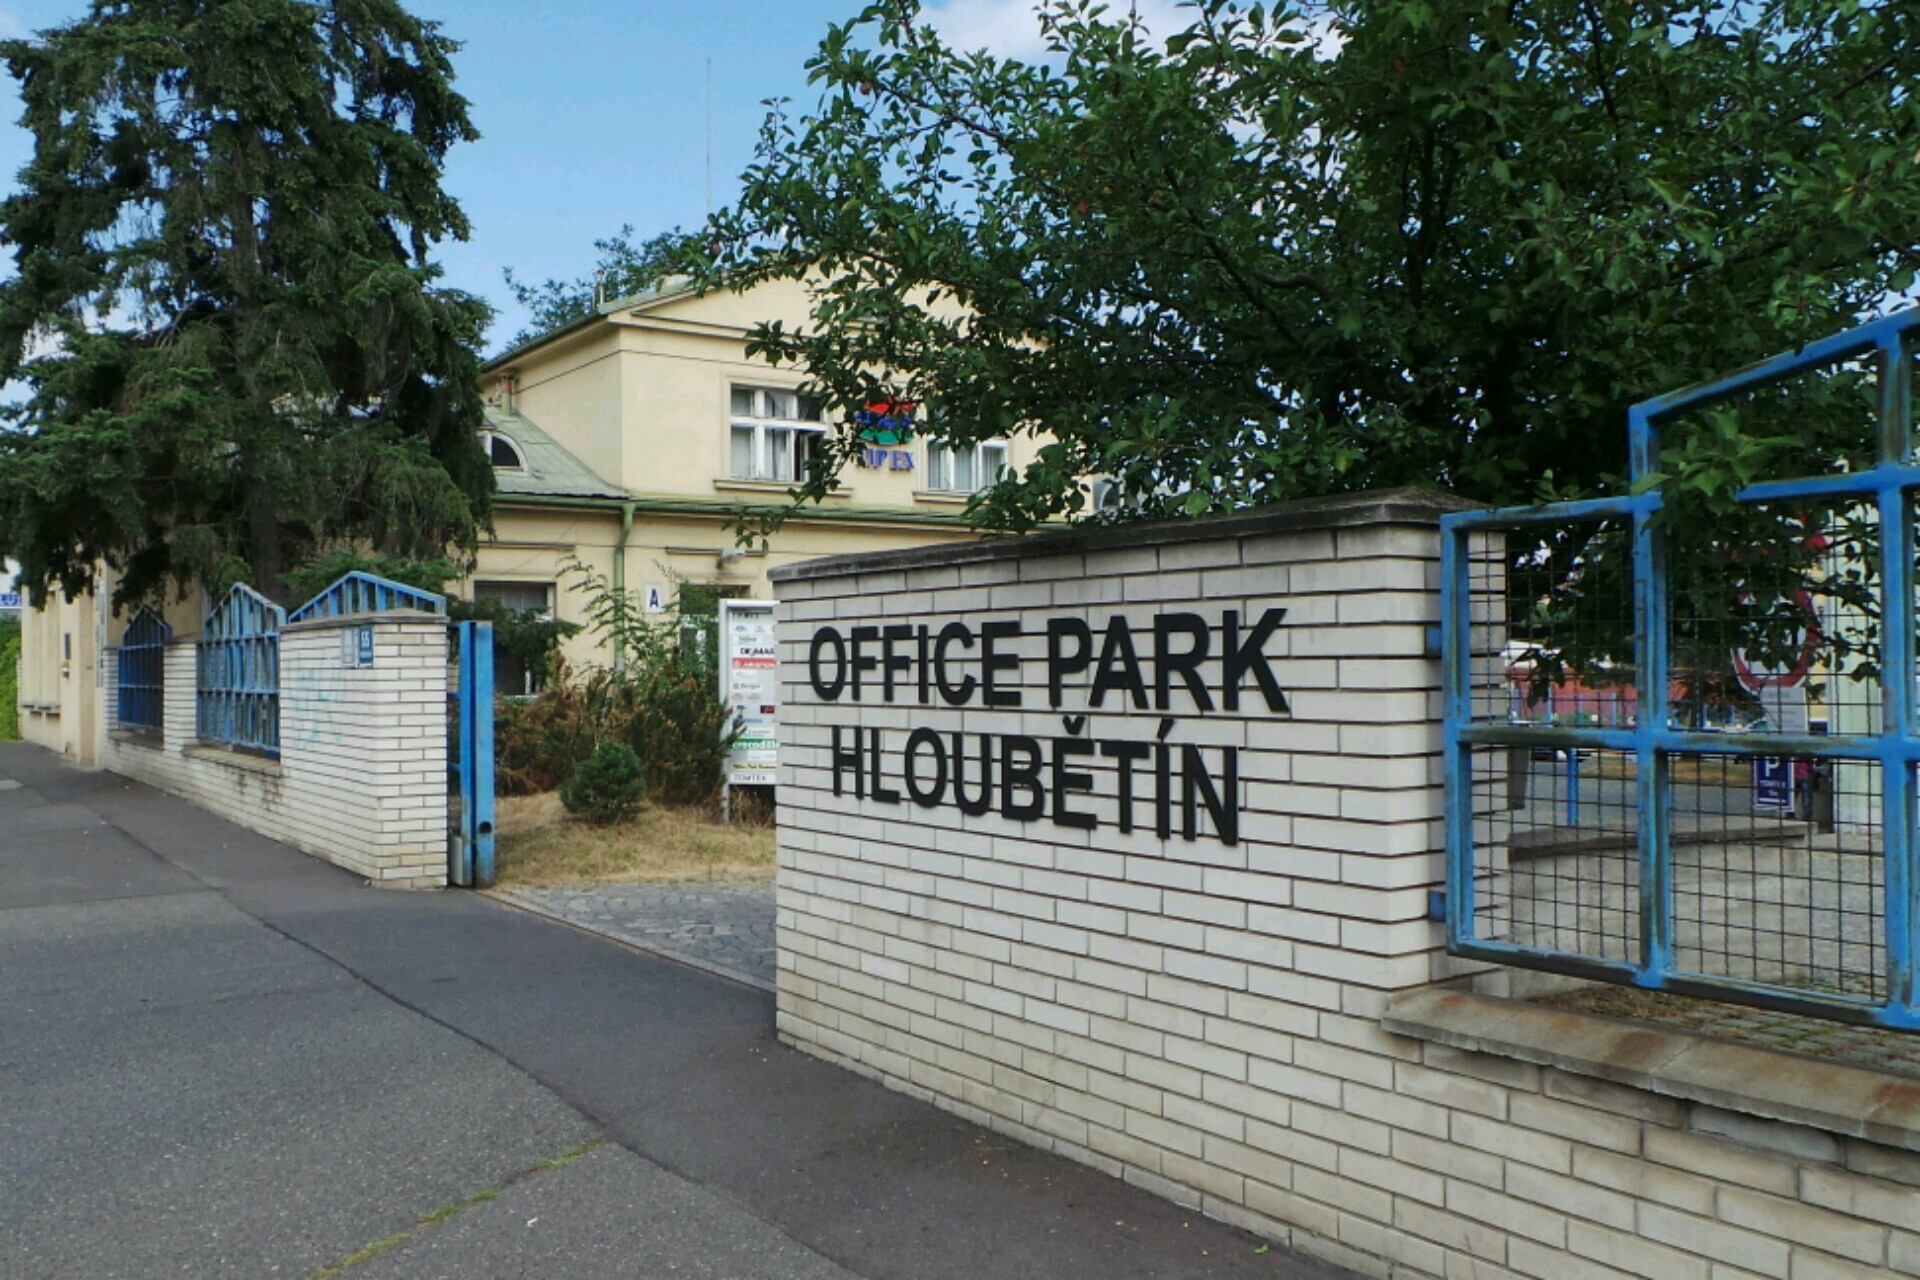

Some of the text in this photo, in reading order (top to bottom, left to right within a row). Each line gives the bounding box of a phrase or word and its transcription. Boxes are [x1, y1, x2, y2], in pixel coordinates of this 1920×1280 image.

[649, 588, 659, 607] A
[809, 607, 1292, 714] OFFICE PARK
[831, 715, 1239, 848] HLOUBĚTÍN
[1765, 756, 1780, 777] P
